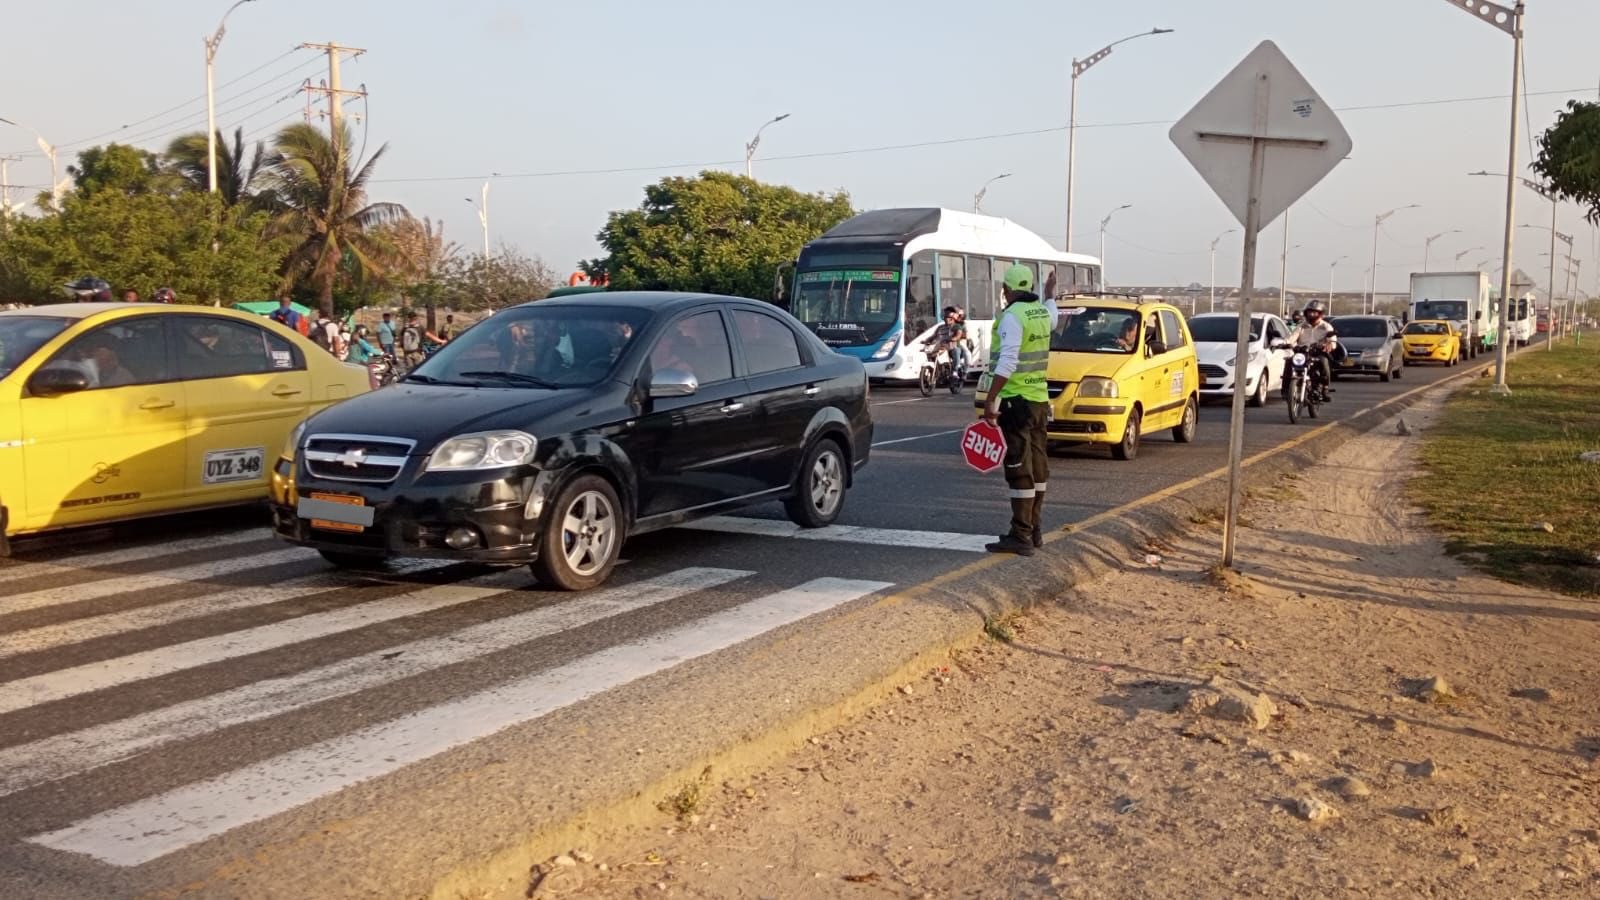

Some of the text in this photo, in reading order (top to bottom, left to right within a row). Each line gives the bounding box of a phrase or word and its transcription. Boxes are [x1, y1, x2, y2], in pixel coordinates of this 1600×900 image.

[964, 430, 1003, 464] PARE
[207, 456, 261, 478] UYZ 348
